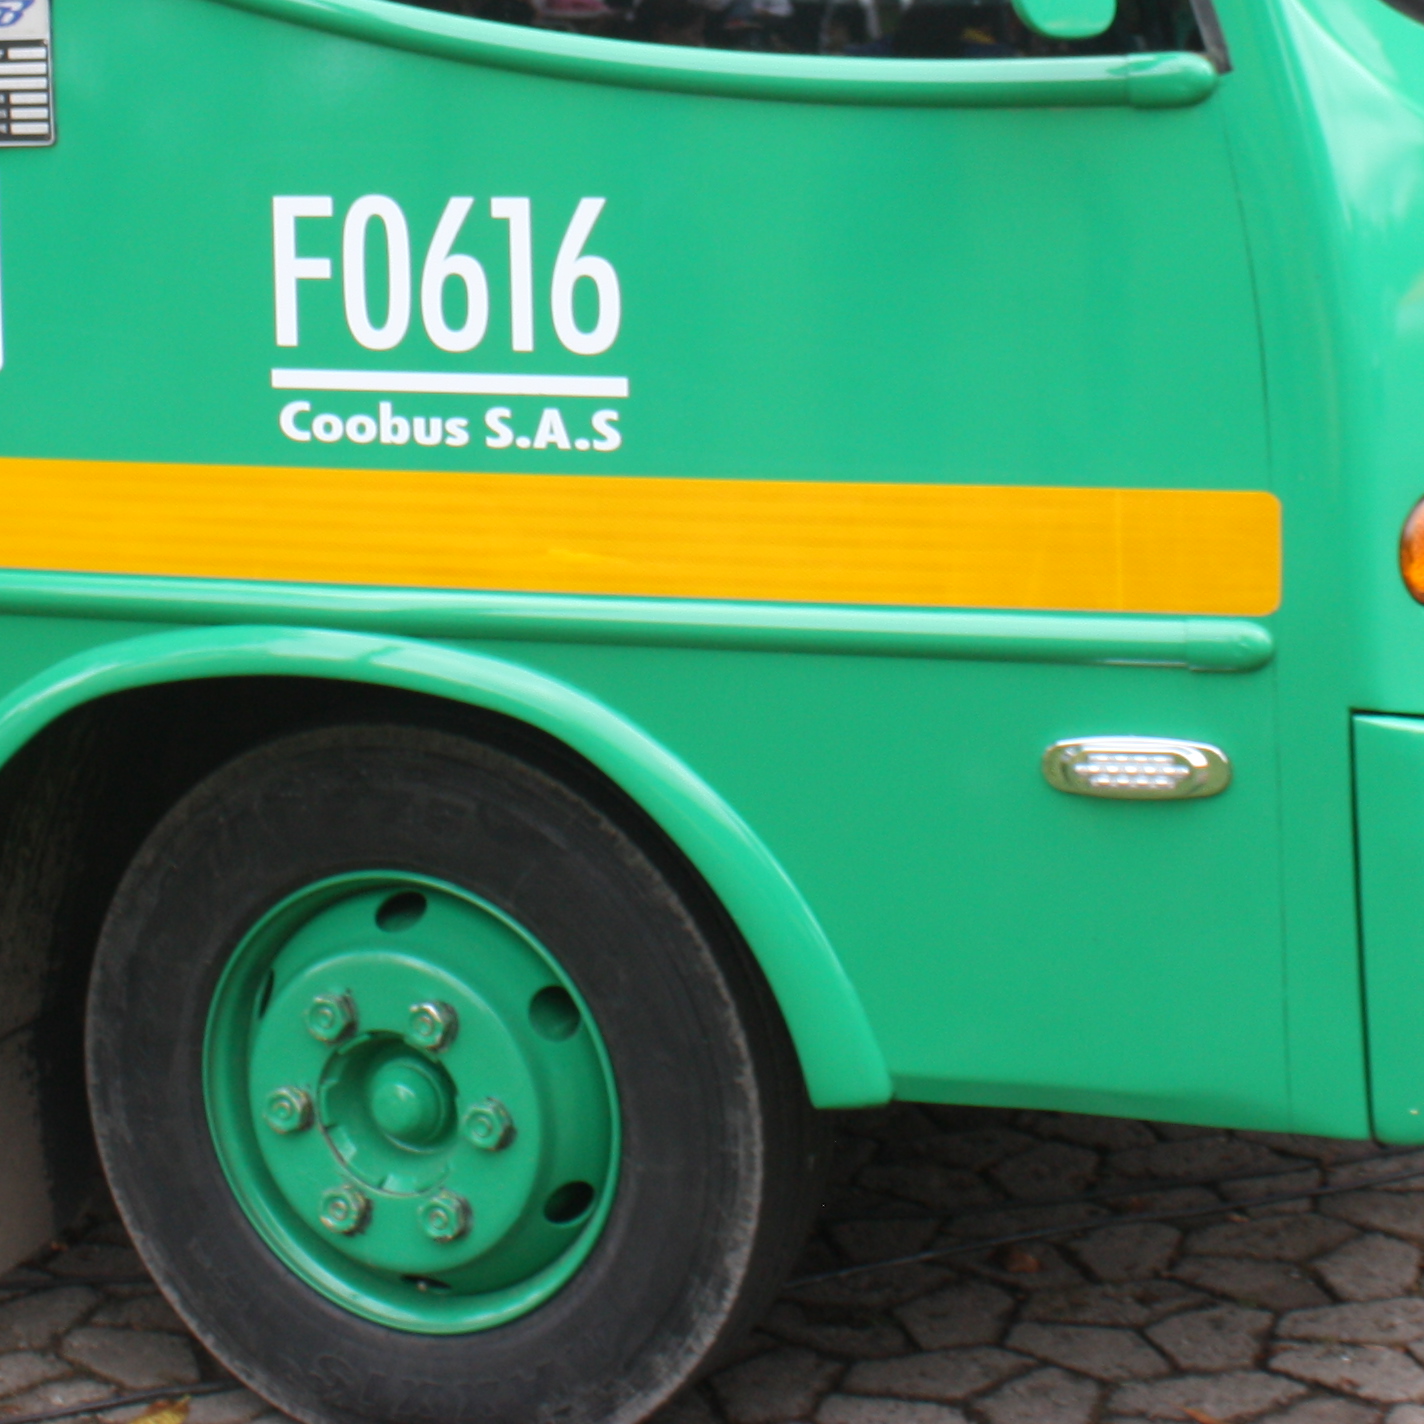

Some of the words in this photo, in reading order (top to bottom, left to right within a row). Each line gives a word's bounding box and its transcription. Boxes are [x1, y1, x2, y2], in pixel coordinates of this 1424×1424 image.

[272, 194, 622, 356] F0616
[279, 400, 470, 447] Coobus
[484, 406, 622, 452] S.A.S
